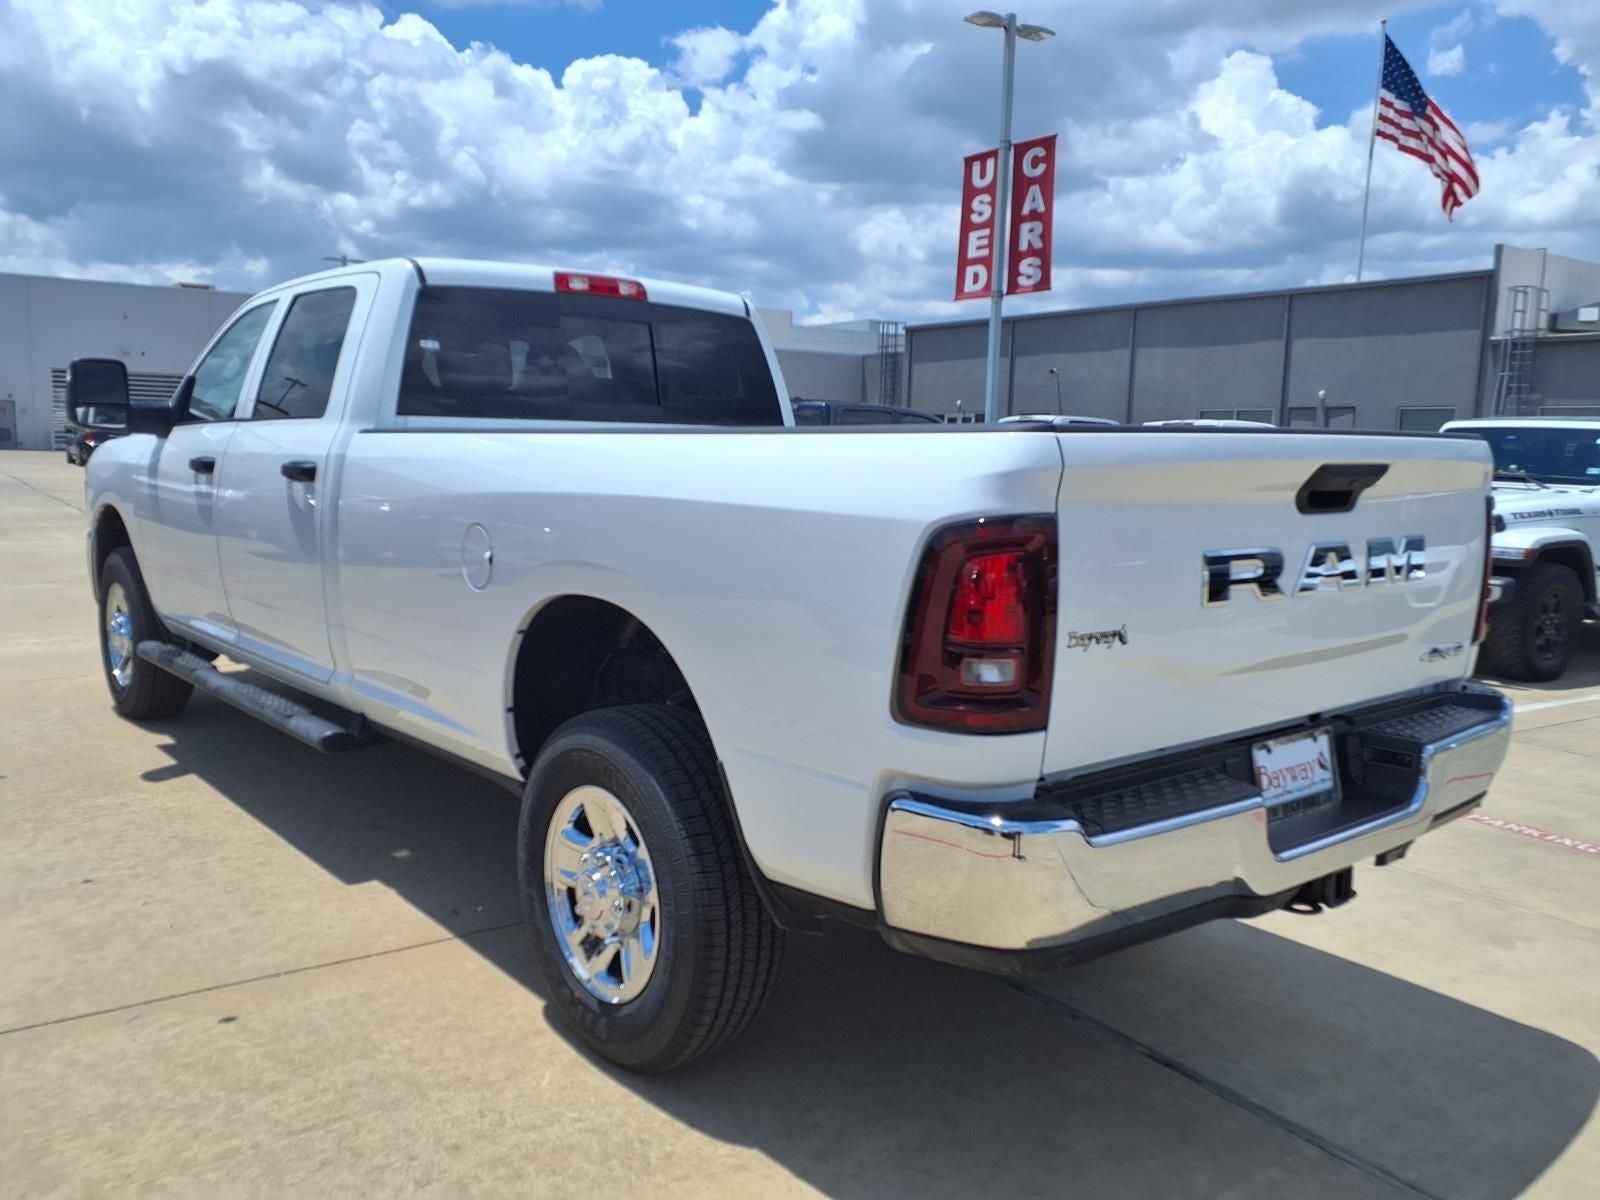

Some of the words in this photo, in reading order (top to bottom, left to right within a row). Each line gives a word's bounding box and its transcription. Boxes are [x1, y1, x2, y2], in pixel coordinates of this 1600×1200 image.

[963, 157, 995, 294] USED
[1016, 146, 1048, 287] CARS
[1201, 534, 1427, 608] RAM
